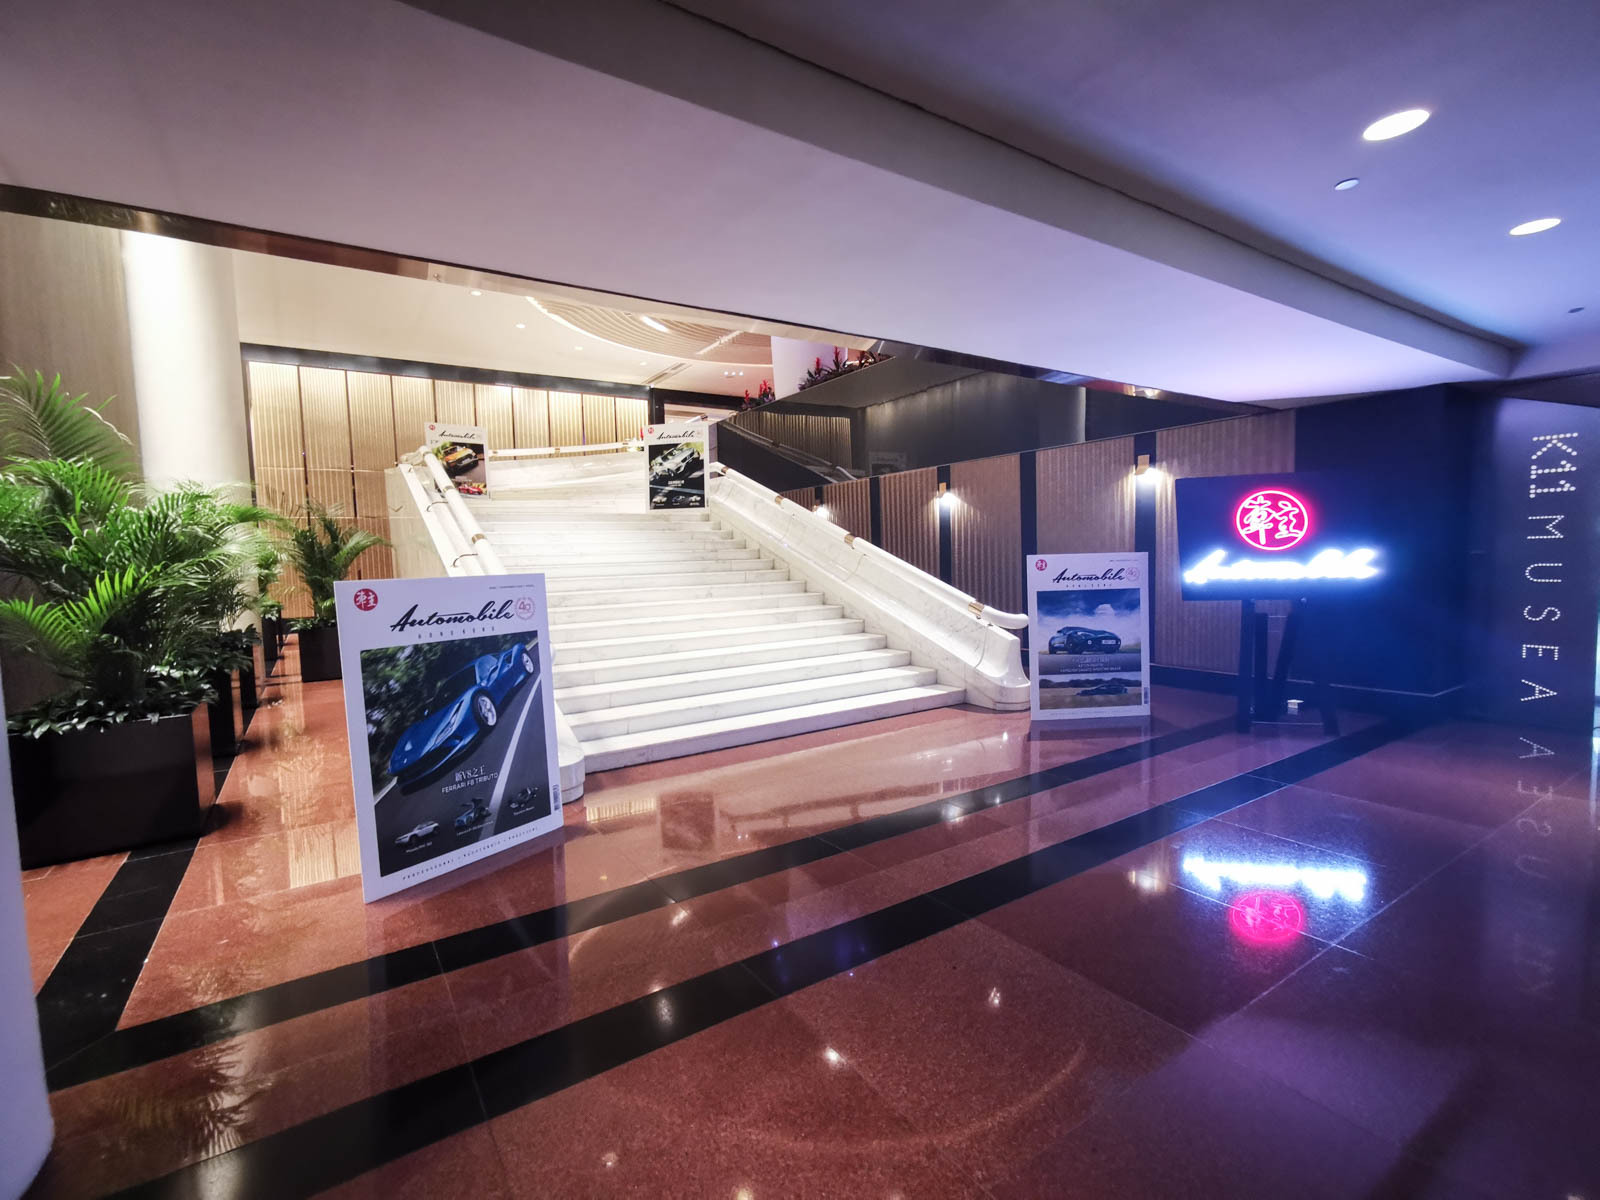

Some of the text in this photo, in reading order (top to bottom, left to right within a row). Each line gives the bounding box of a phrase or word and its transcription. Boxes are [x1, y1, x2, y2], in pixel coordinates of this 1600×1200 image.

[1053, 568, 1126, 584] Automobile
[1520, 432, 1578, 702] K11 MUSEA
[390, 599, 514, 632] Automobile
